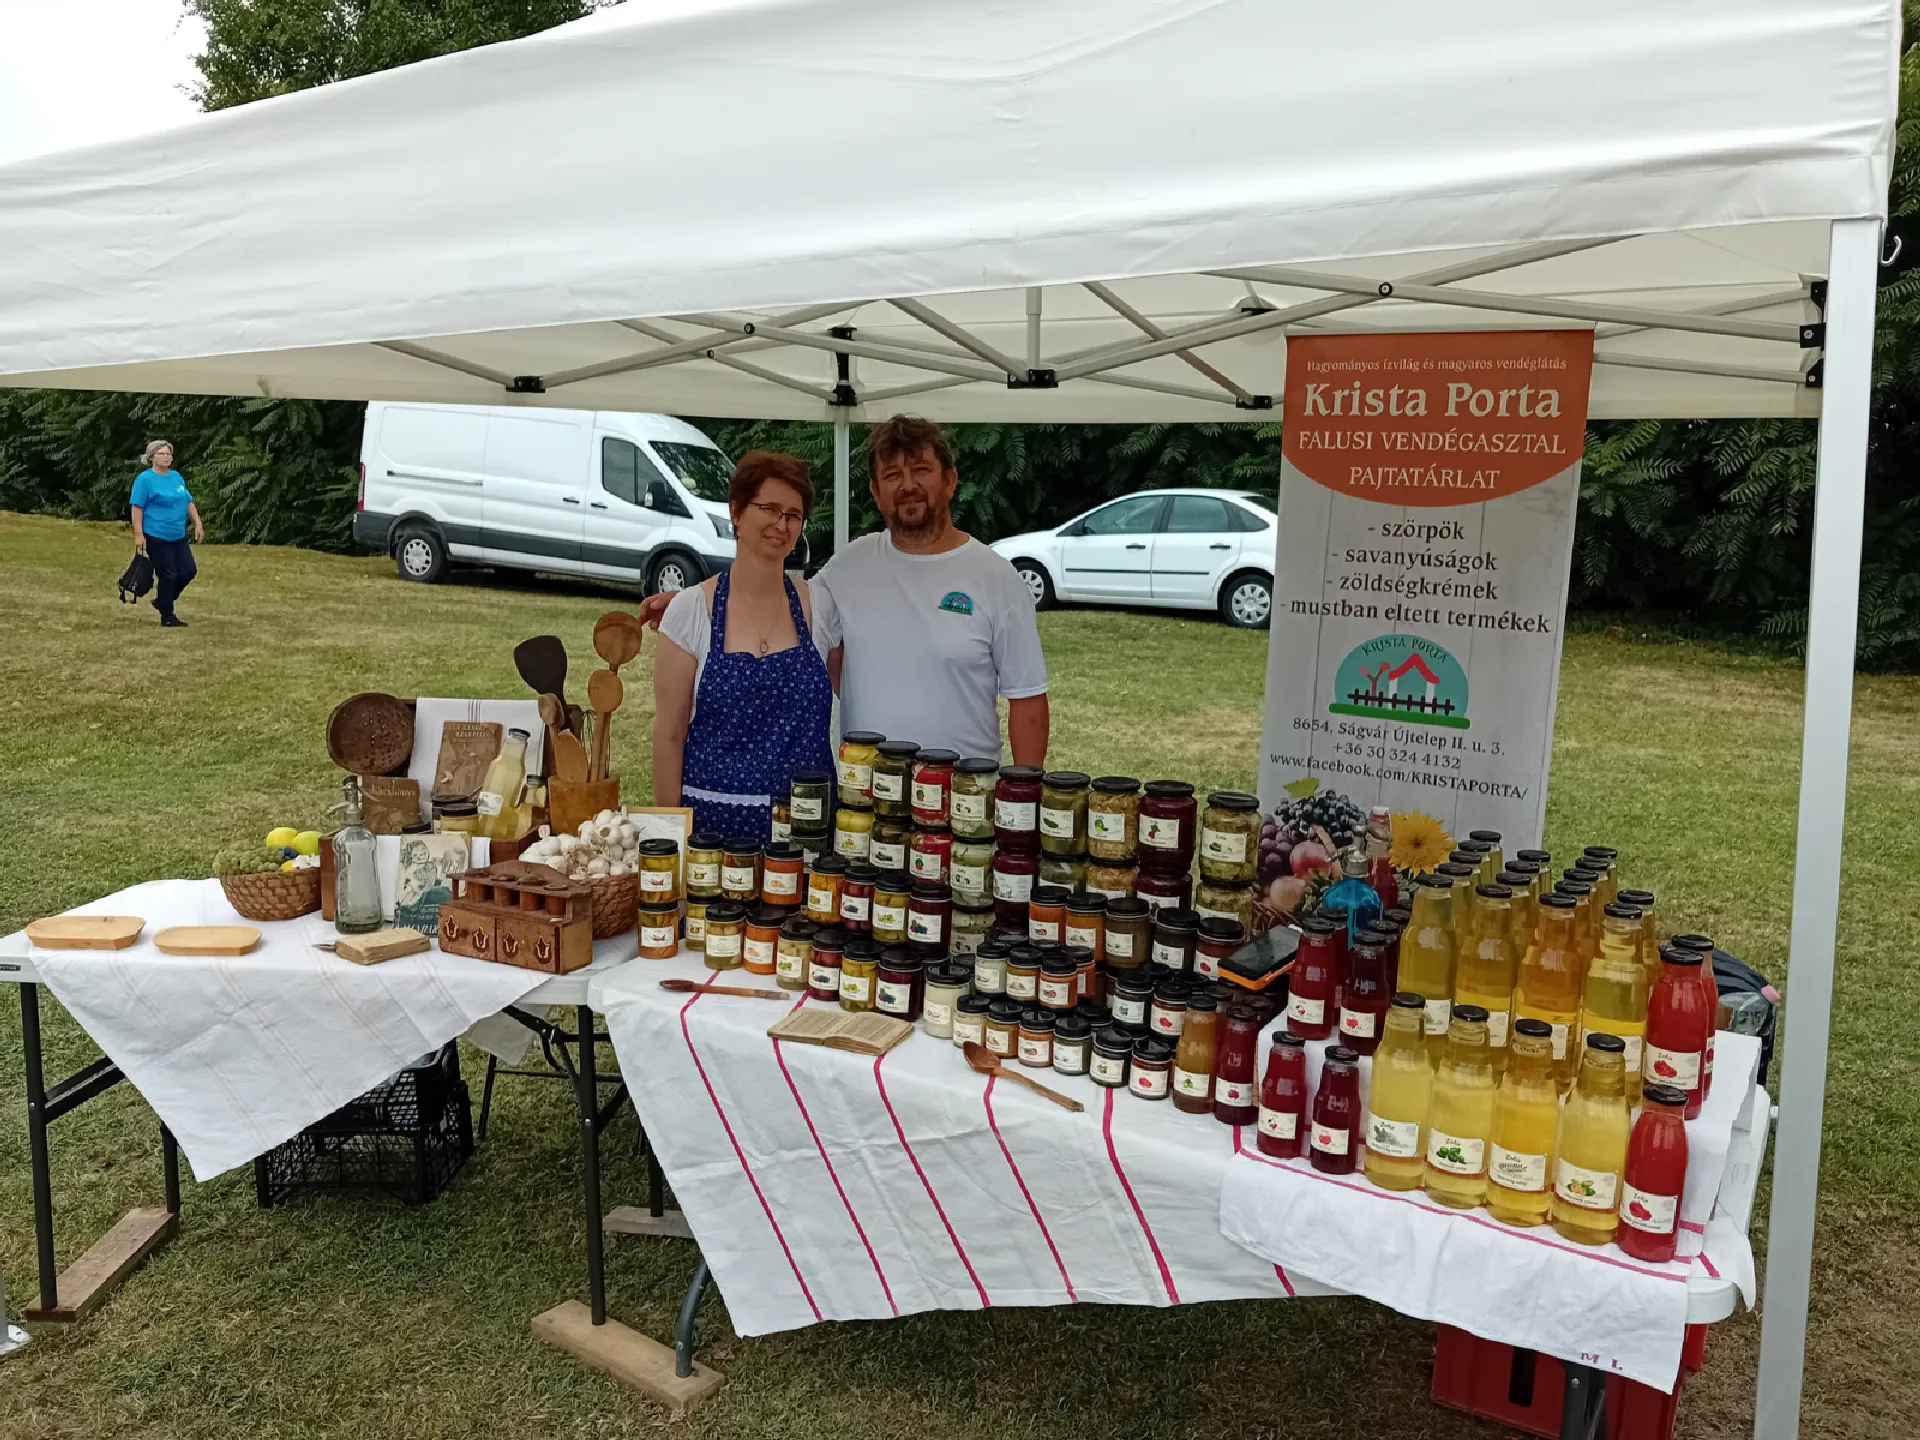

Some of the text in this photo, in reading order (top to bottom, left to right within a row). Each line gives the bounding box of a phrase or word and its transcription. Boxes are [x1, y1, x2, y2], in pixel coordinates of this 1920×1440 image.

[1307, 359, 1380, 374] Hagyományos
[1423, 358, 1434, 370] és
[1438, 359, 1493, 371] magyaros
[1496, 357, 1567, 371] vendéglátás
[1304, 381, 1562, 418] Krista Porta
[1299, 426, 1566, 455] FALUSI VENDÉGASZTAL
[1349, 462, 1500, 490] PAJTATÁRLAT
[1381, 519, 1465, 544] szörpök
[1345, 548, 1498, 575] savanyúságok
[1340, 572, 1498, 600] zöldségkrémek
[1290, 599, 1378, 620] mustban
[1384, 603, 1441, 625] eltett
[1447, 609, 1551, 634] termékek
[1361, 638, 1447, 663] KRISTA PORTA
[1292, 717, 1333, 735] 8654,
[1337, 721, 1390, 741] Ságvár
[1393, 725, 1447, 750] Újtelep
[1472, 741, 1486, 753] u.
[1490, 741, 1505, 756] 3.
[1333, 741, 1461, 769] +36 30 324 4132
[1270, 752, 1528, 801] www.facebook.com/KRISTAPORTA/
[1580, 1352, 1600, 1365] M
